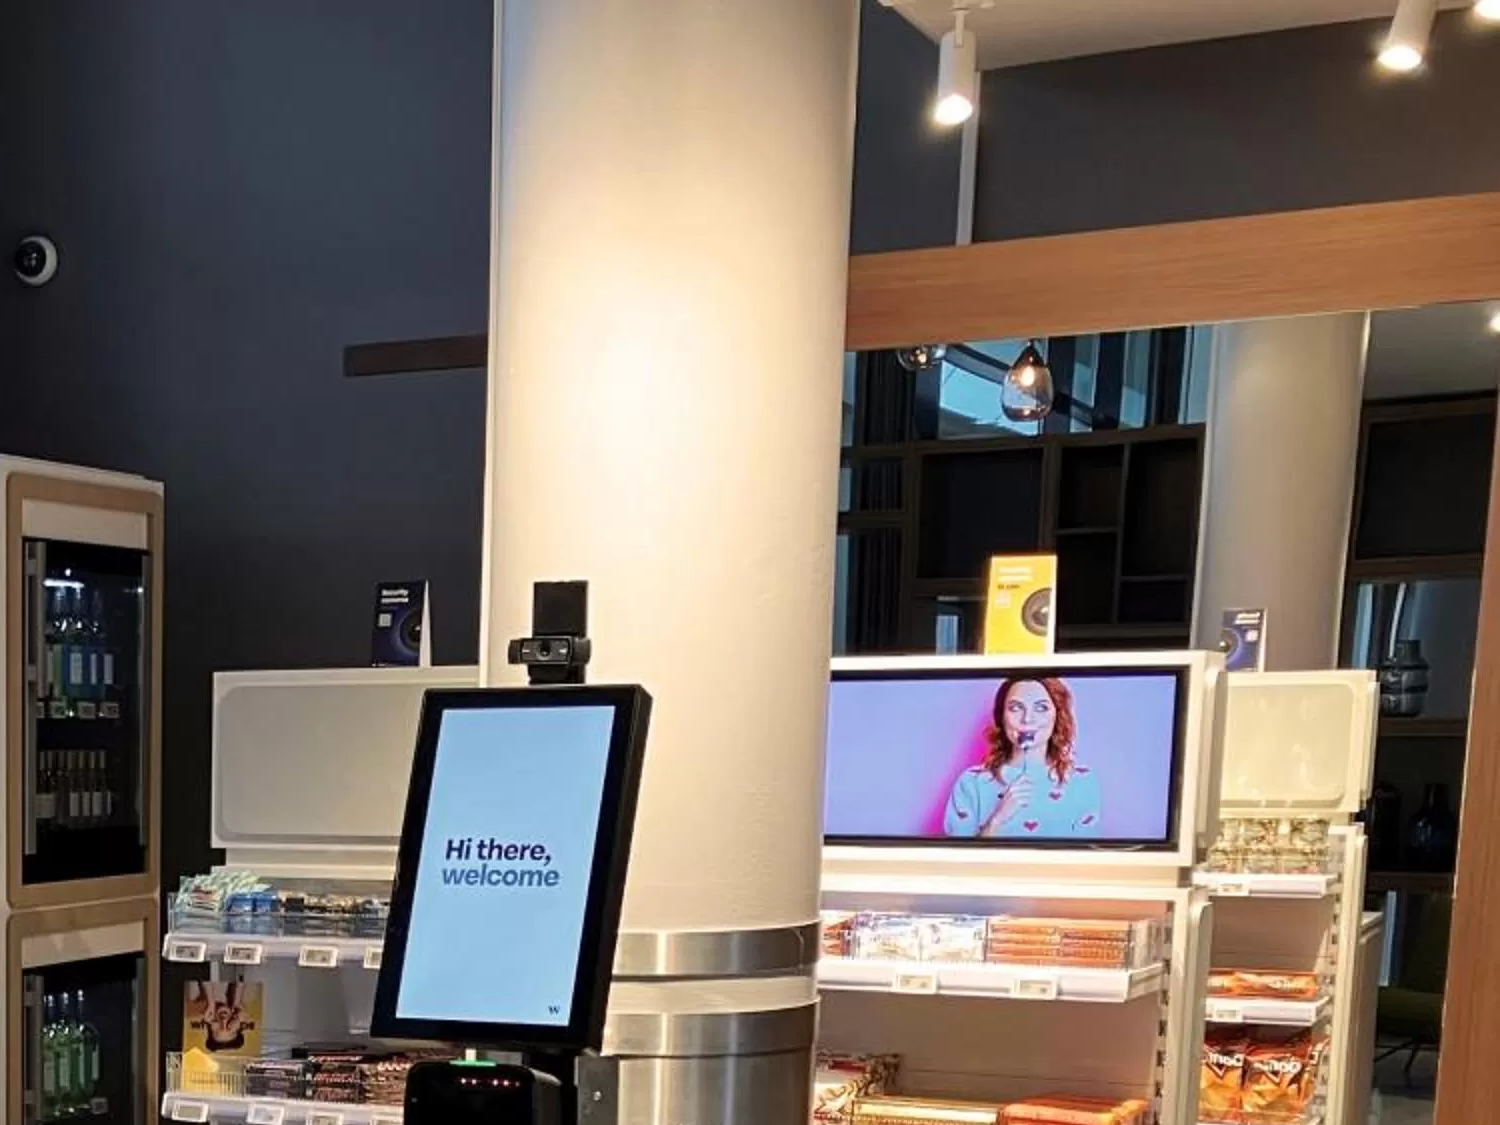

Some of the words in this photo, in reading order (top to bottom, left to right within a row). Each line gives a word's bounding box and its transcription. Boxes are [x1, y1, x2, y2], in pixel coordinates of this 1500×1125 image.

[445, 837, 472, 861] Hi
[476, 837, 551, 867] there,
[441, 863, 560, 887] welcome
